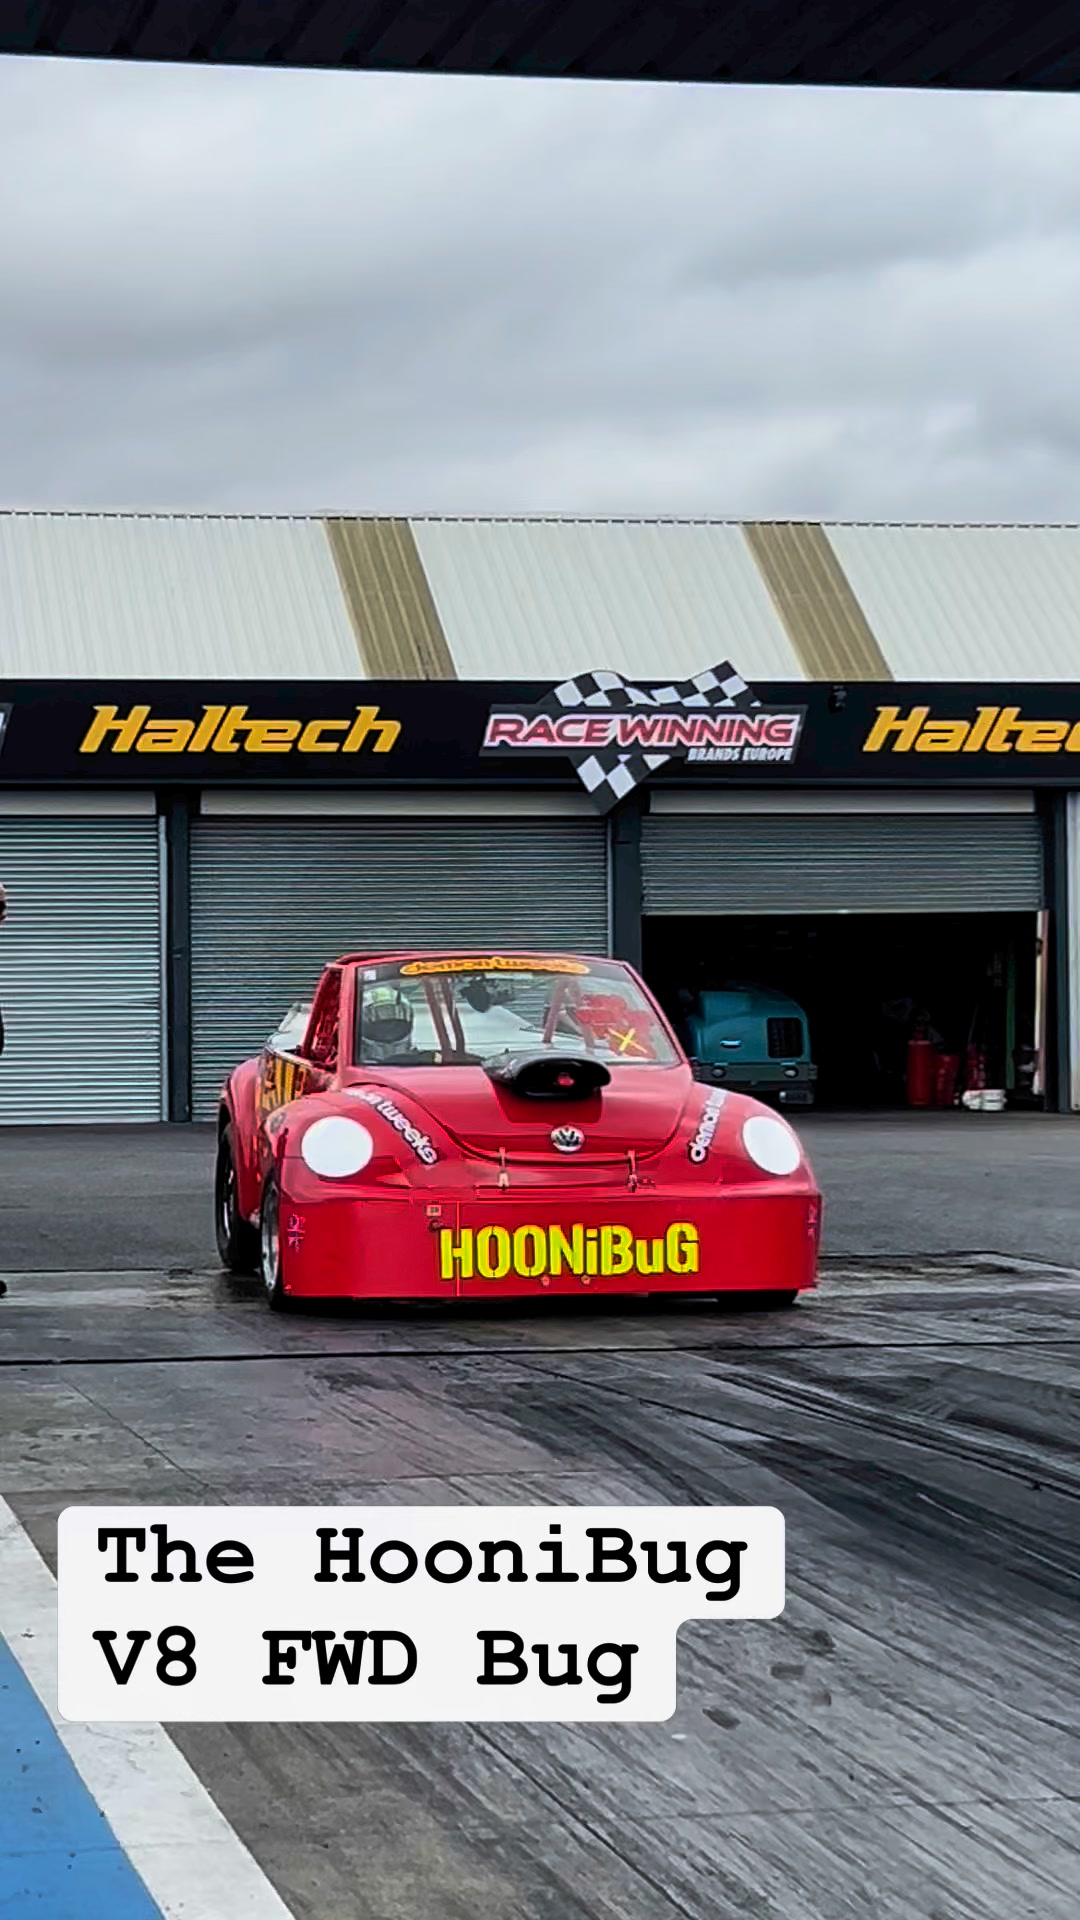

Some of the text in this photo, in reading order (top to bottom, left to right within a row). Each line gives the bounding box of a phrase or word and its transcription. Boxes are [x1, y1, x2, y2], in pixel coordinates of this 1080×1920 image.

[79, 705, 401, 753] Haltech
[484, 713, 800, 747] RACE WINNING
[687, 747, 793, 761] BRANDS EUROPE
